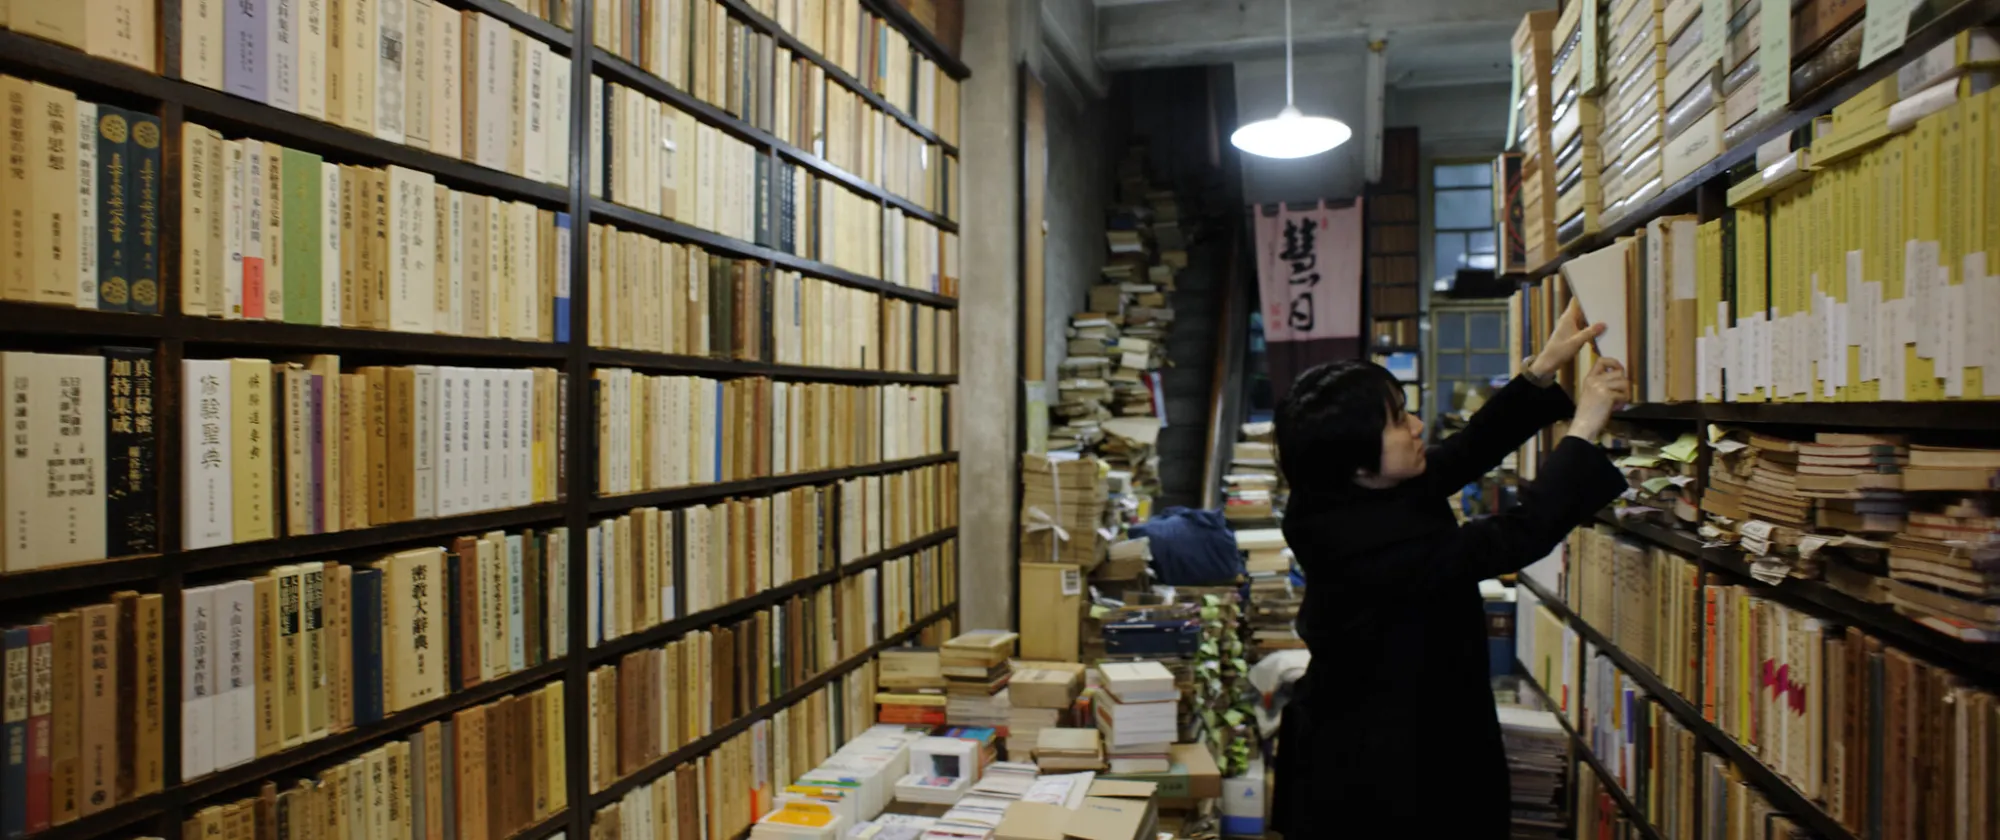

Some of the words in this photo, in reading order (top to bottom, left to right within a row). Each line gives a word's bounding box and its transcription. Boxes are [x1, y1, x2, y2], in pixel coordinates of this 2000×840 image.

[47, 101, 65, 170] 法華思想
[111, 357, 133, 433] 加持集成
[135, 358, 154, 433] 真言秘密
